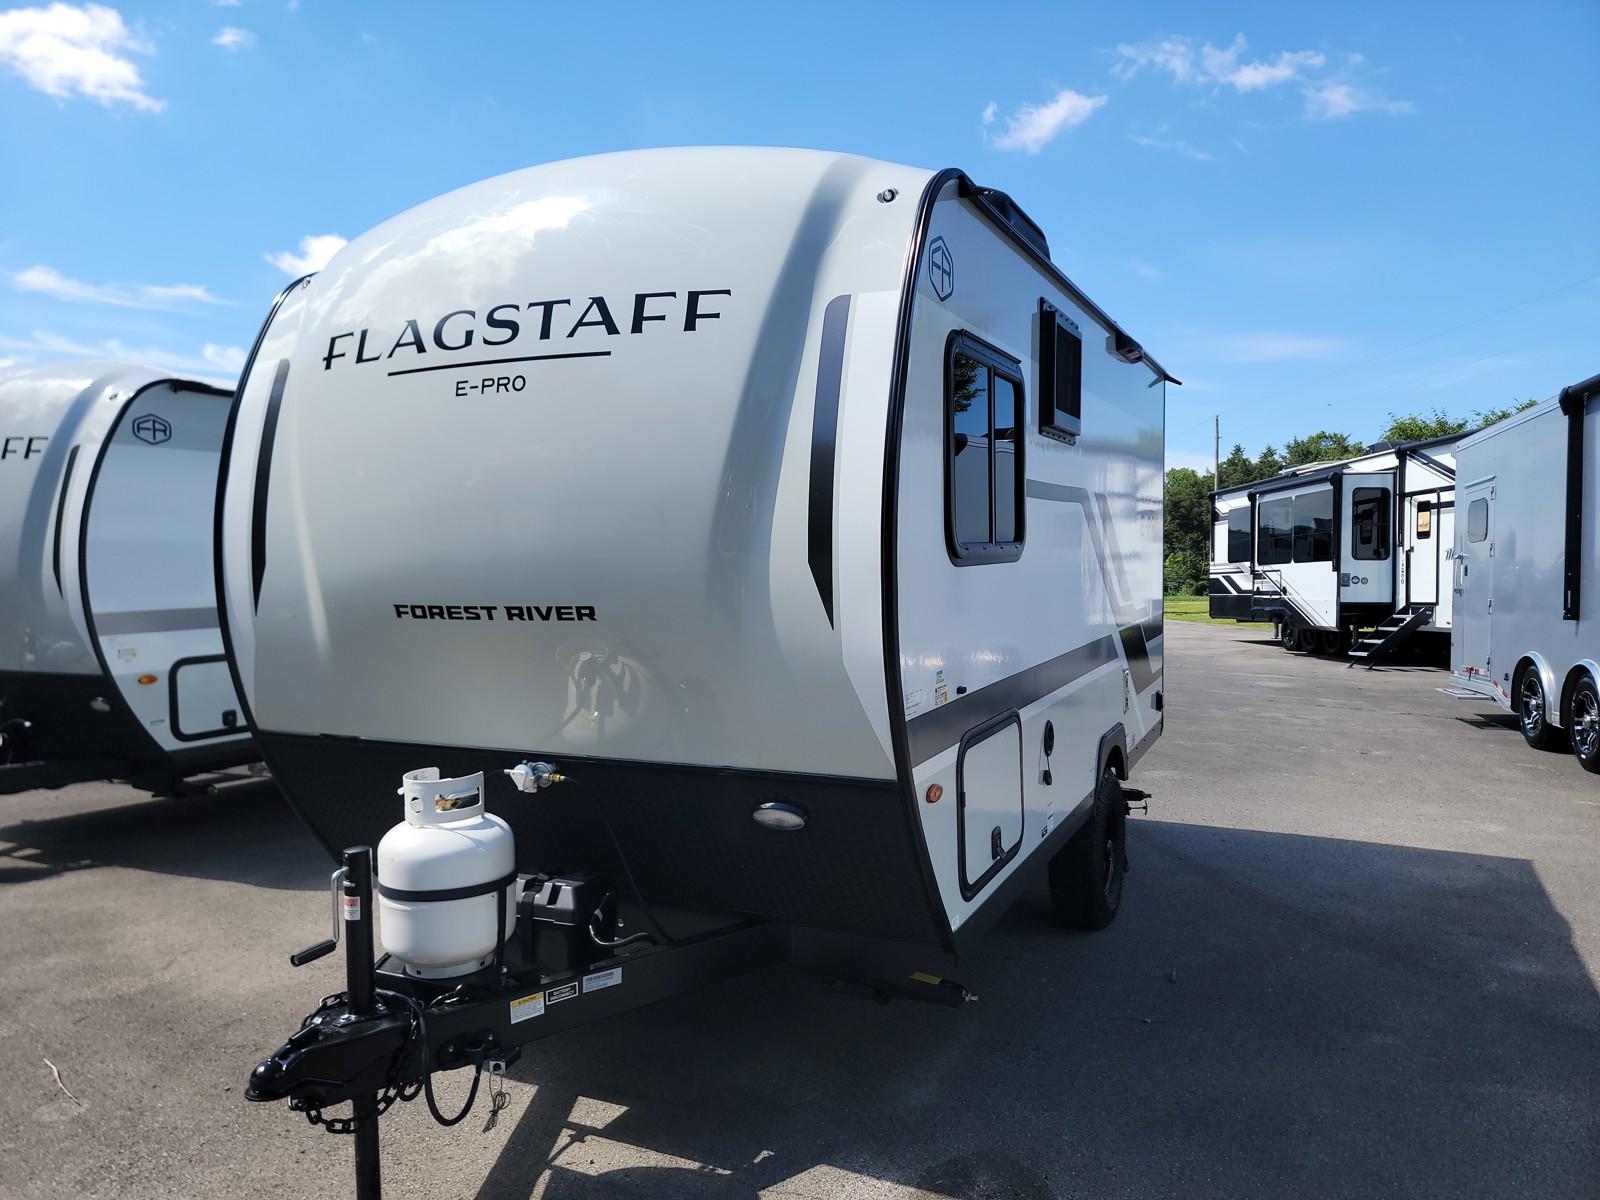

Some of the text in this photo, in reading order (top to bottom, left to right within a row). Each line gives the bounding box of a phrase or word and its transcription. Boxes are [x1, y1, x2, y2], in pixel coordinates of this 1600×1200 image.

[322, 288, 732, 370] FLAGSTAFF
[454, 374, 527, 397] E-PRO
[393, 603, 598, 622] FOREST RIVER
